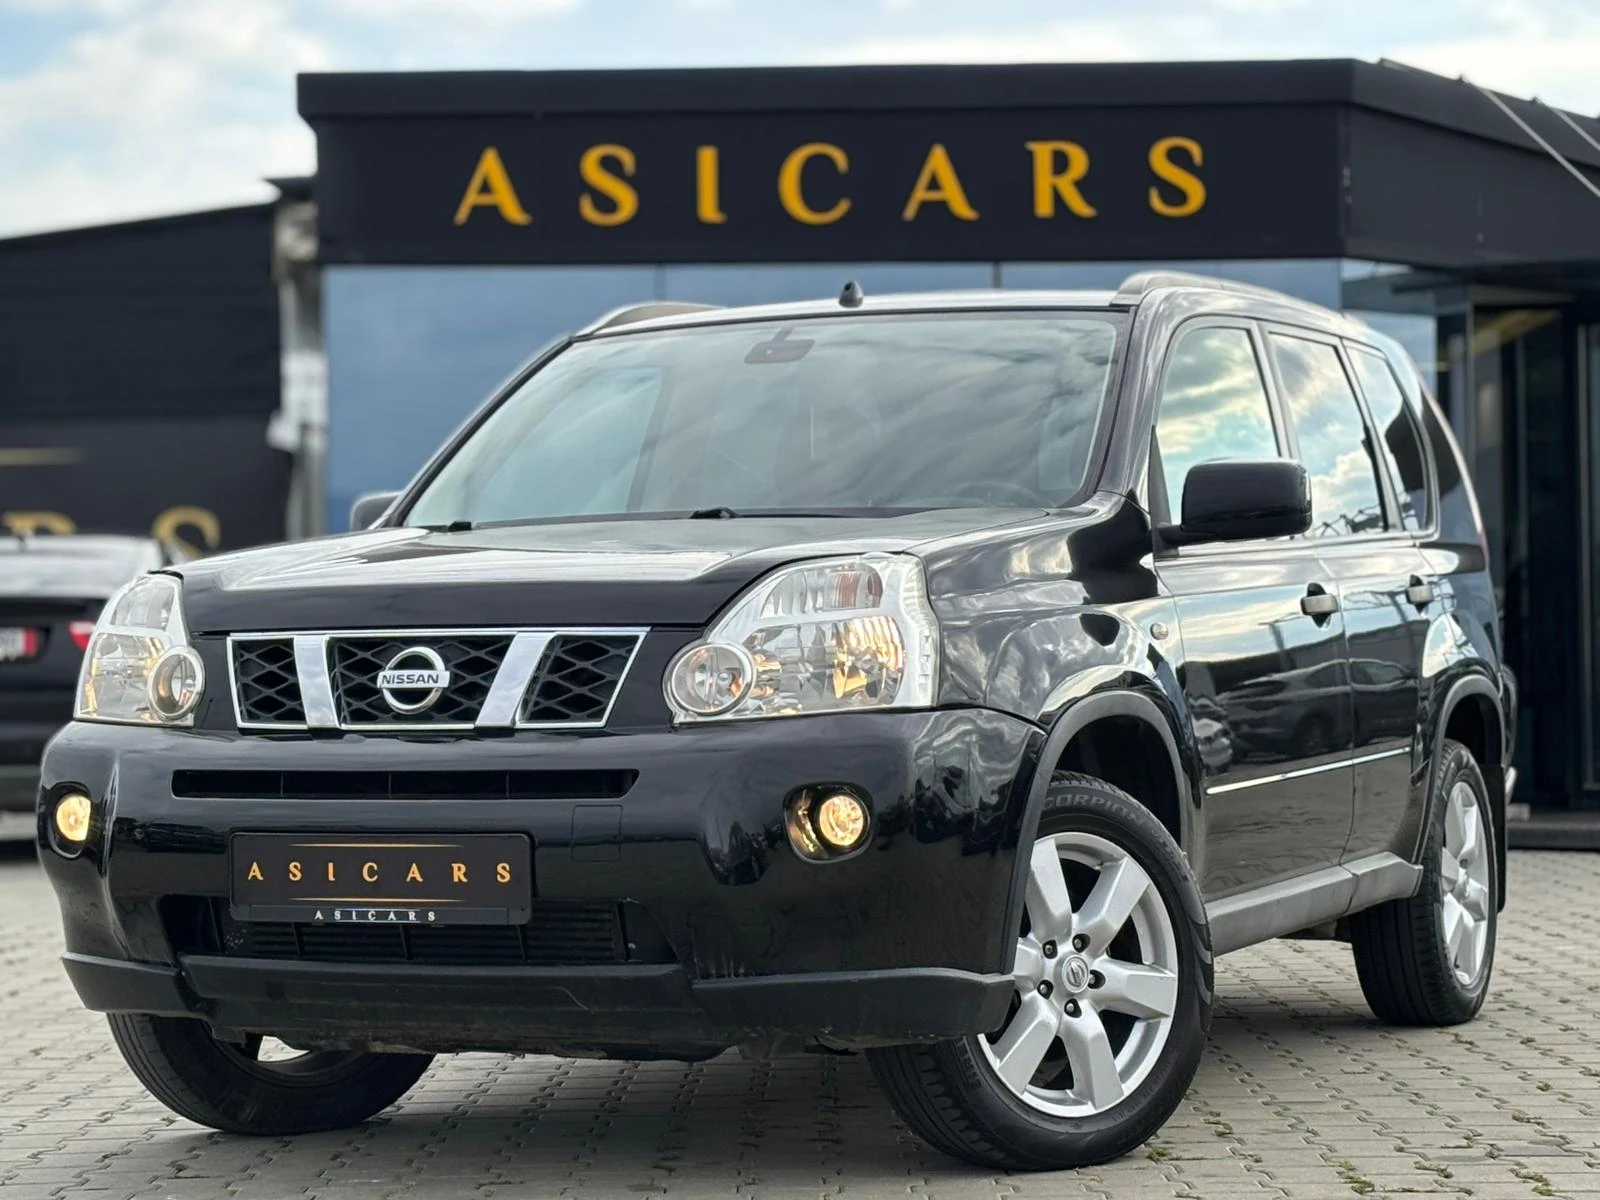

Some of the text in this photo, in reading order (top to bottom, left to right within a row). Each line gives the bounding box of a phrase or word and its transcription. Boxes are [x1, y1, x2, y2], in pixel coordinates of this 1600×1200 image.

[453, 136, 1207, 226] ASICARS
[381, 673, 440, 685] NISSAN
[1043, 793, 1146, 826] CORPION
[247, 862, 512, 884] ASICARS
[314, 910, 436, 922] ASICARS
